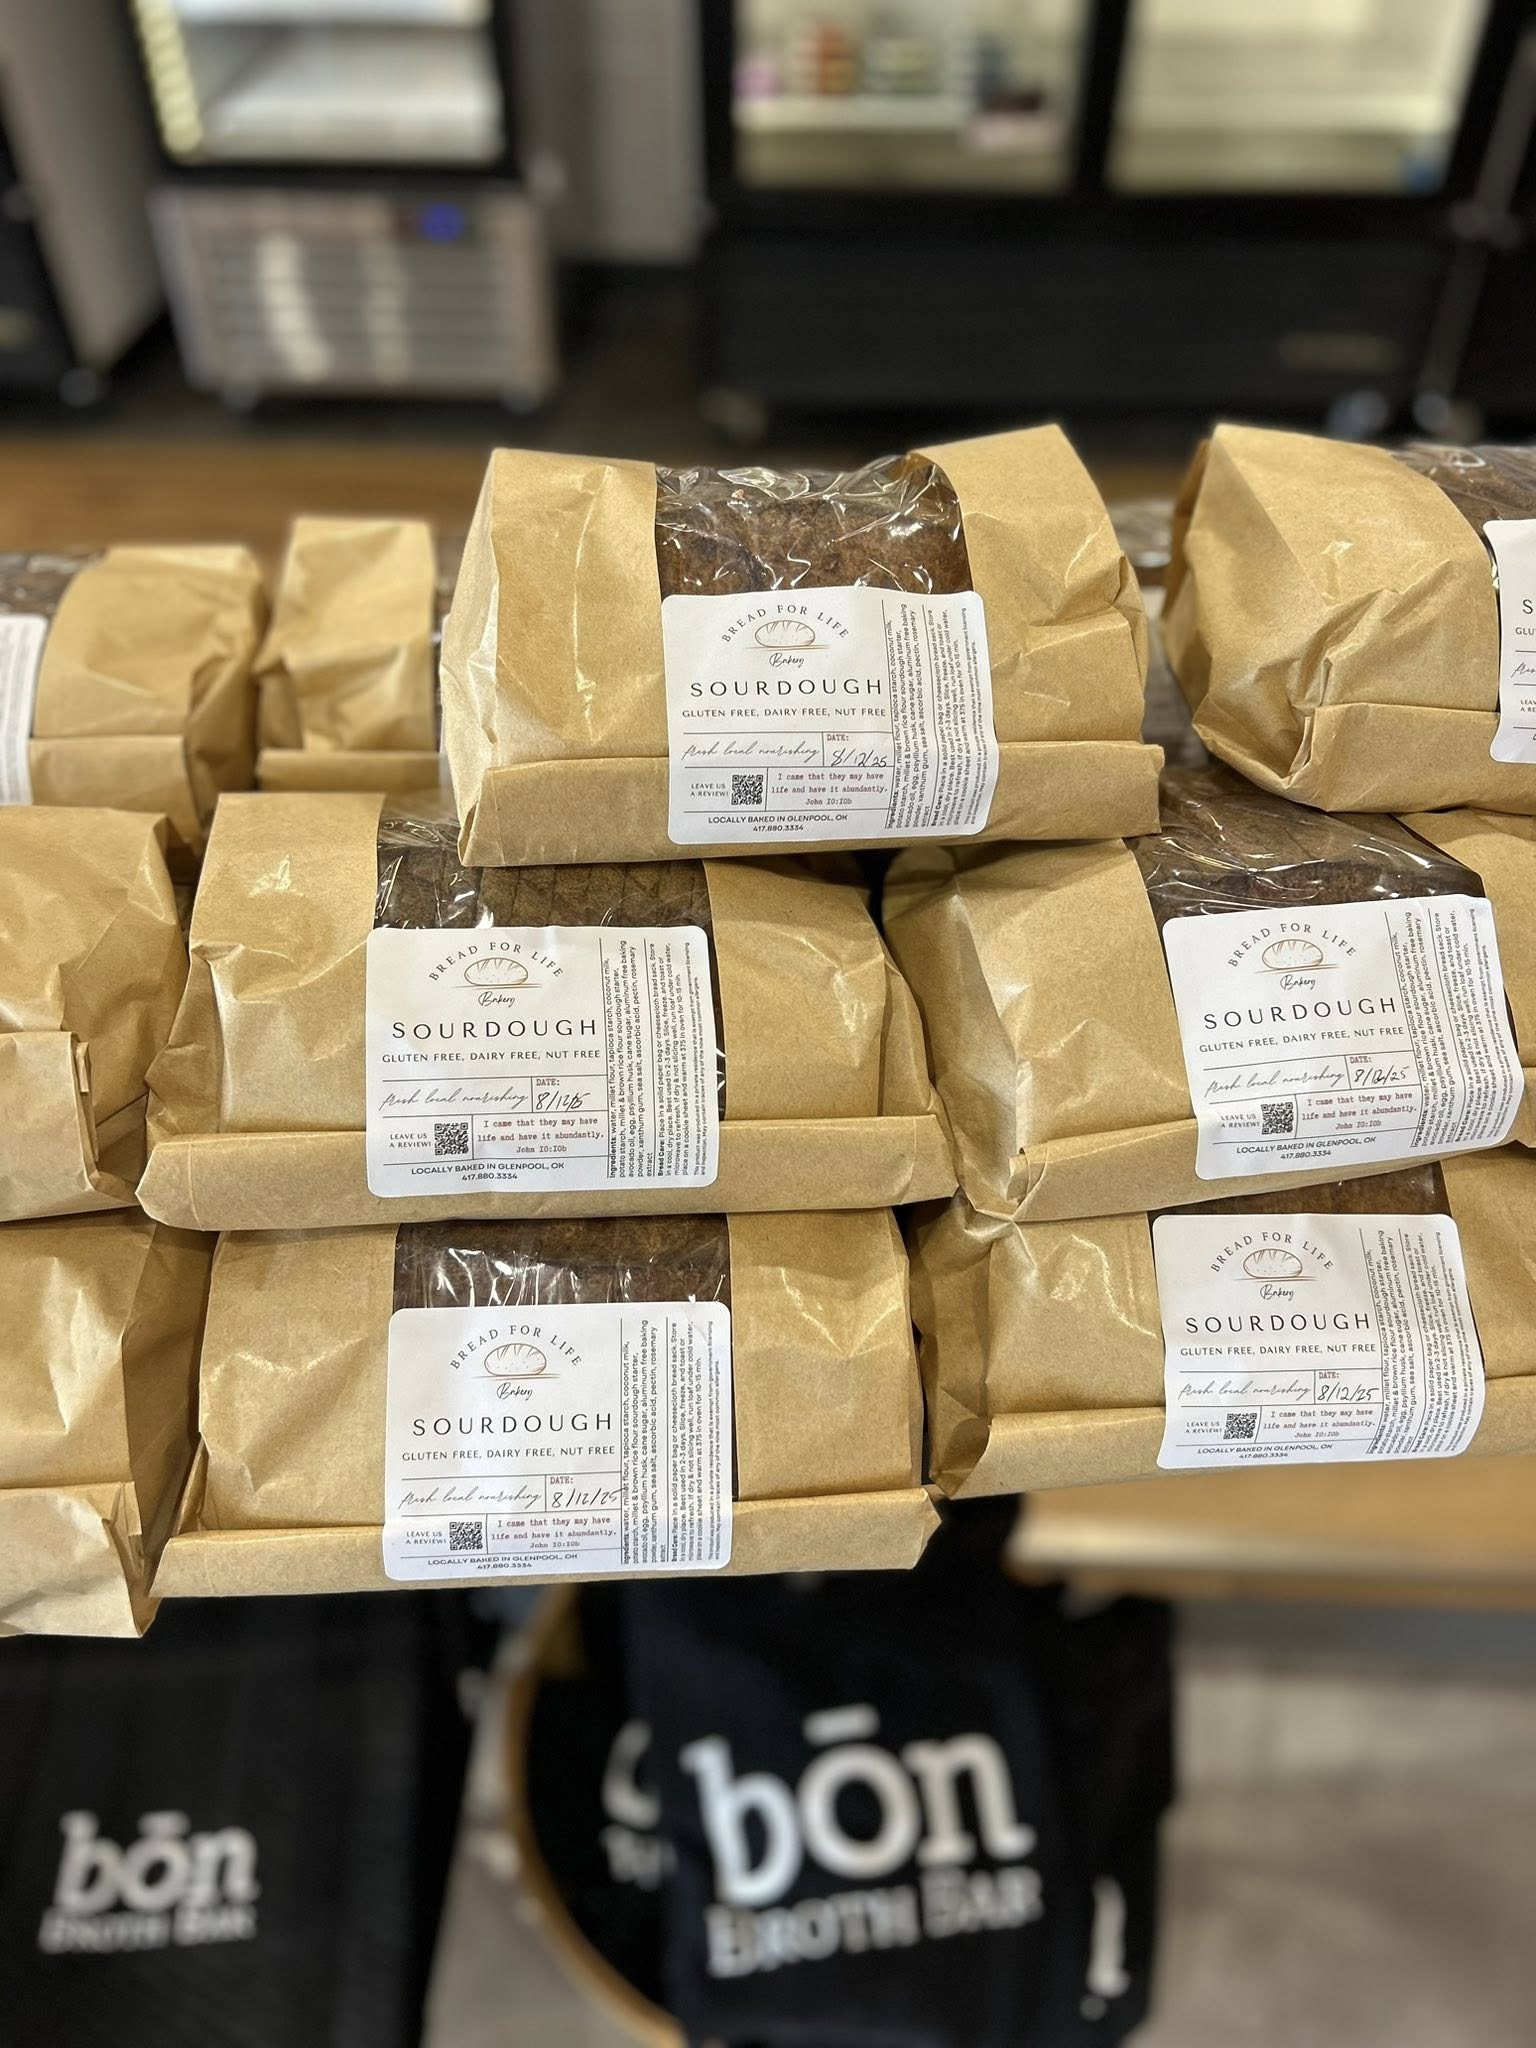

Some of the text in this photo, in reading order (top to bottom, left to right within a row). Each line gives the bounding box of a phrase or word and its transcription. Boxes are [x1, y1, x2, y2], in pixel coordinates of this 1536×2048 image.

[722, 604, 849, 642] BREAD FOR LIFE
[769, 653, 804, 668] Bakery
[691, 679, 881, 697] SOURDOUGH
[682, 708, 886, 717] GLUTEN FREE, DAIRY FREE, NUT FREE
[681, 741, 820, 764] fresh local nourishing
[708, 816, 746, 824] LOCALLY
[788, 814, 833, 822] GLENPOOL,
[1228, 923, 1357, 967] BREAD FOR LIFE
[428, 942, 564, 981] BREAD FOR LIFE
[1280, 974, 1315, 991] Bakery
[478, 991, 516, 1007] Bakery
[1204, 997, 1396, 1030] SOURDOUGH
[392, 1019, 596, 1040] SOURDOUGH
[1200, 1027, 1404, 1052] GLUTEN FREE, DAIRY FREE, NUT FREE
[382, 1050, 600, 1063] GLUTEN FREE, DAIRY FREE, NUT FREE
[536, 1078, 560, 1086] DATE:
[1204, 1065, 1345, 1098] fresh local nourishing
[379, 1086, 528, 1111] fresh local nourishing
[484, 1120, 489, 1128] I
[517, 1119, 534, 1127] that
[539, 1118, 557, 1128] they
[561, 1118, 577, 1127] may
[478, 1134, 496, 1142] life
[542, 1132, 550, 1140] it
[555, 1130, 604, 1140] abundantly.
[1236, 1146, 1276, 1154] LOCALLY
[1276, 1142, 1304, 1151] BAKED
[1316, 1138, 1362, 1148] GLENPOOL,
[1364, 1136, 1376, 1144] OK
[411, 1166, 453, 1175] LOCALLY
[455, 1164, 485, 1172] BAKED
[498, 1162, 549, 1170] GLENPOOL,
[462, 1172, 517, 1181] 417.880.3334
[1211, 1232, 1334, 1273] BREAD FOR LIFE
[1260, 1284, 1294, 1301] Bakery
[1186, 1313, 1370, 1334] SOURDOUGH
[450, 1325, 582, 1370] BREAD FOR LIFE
[1180, 1343, 1375, 1356] GLUTEN FREE, DAIRY FREE, NUT FREE
[497, 1382, 533, 1400] Bakery
[1178, 1380, 1311, 1401] fresh local nourishing
[1317, 1382, 1379, 1402] 8/12/25
[413, 1413, 611, 1436] SOURDOUGH
[402, 1446, 615, 1461] GLUTEN FREE, DAIRY FREE, NUT FREE
[550, 1476, 574, 1484] DATE:
[398, 1485, 542, 1509] fresh local nourishing
[552, 1518, 571, 1527] they
[575, 1518, 592, 1526] may
